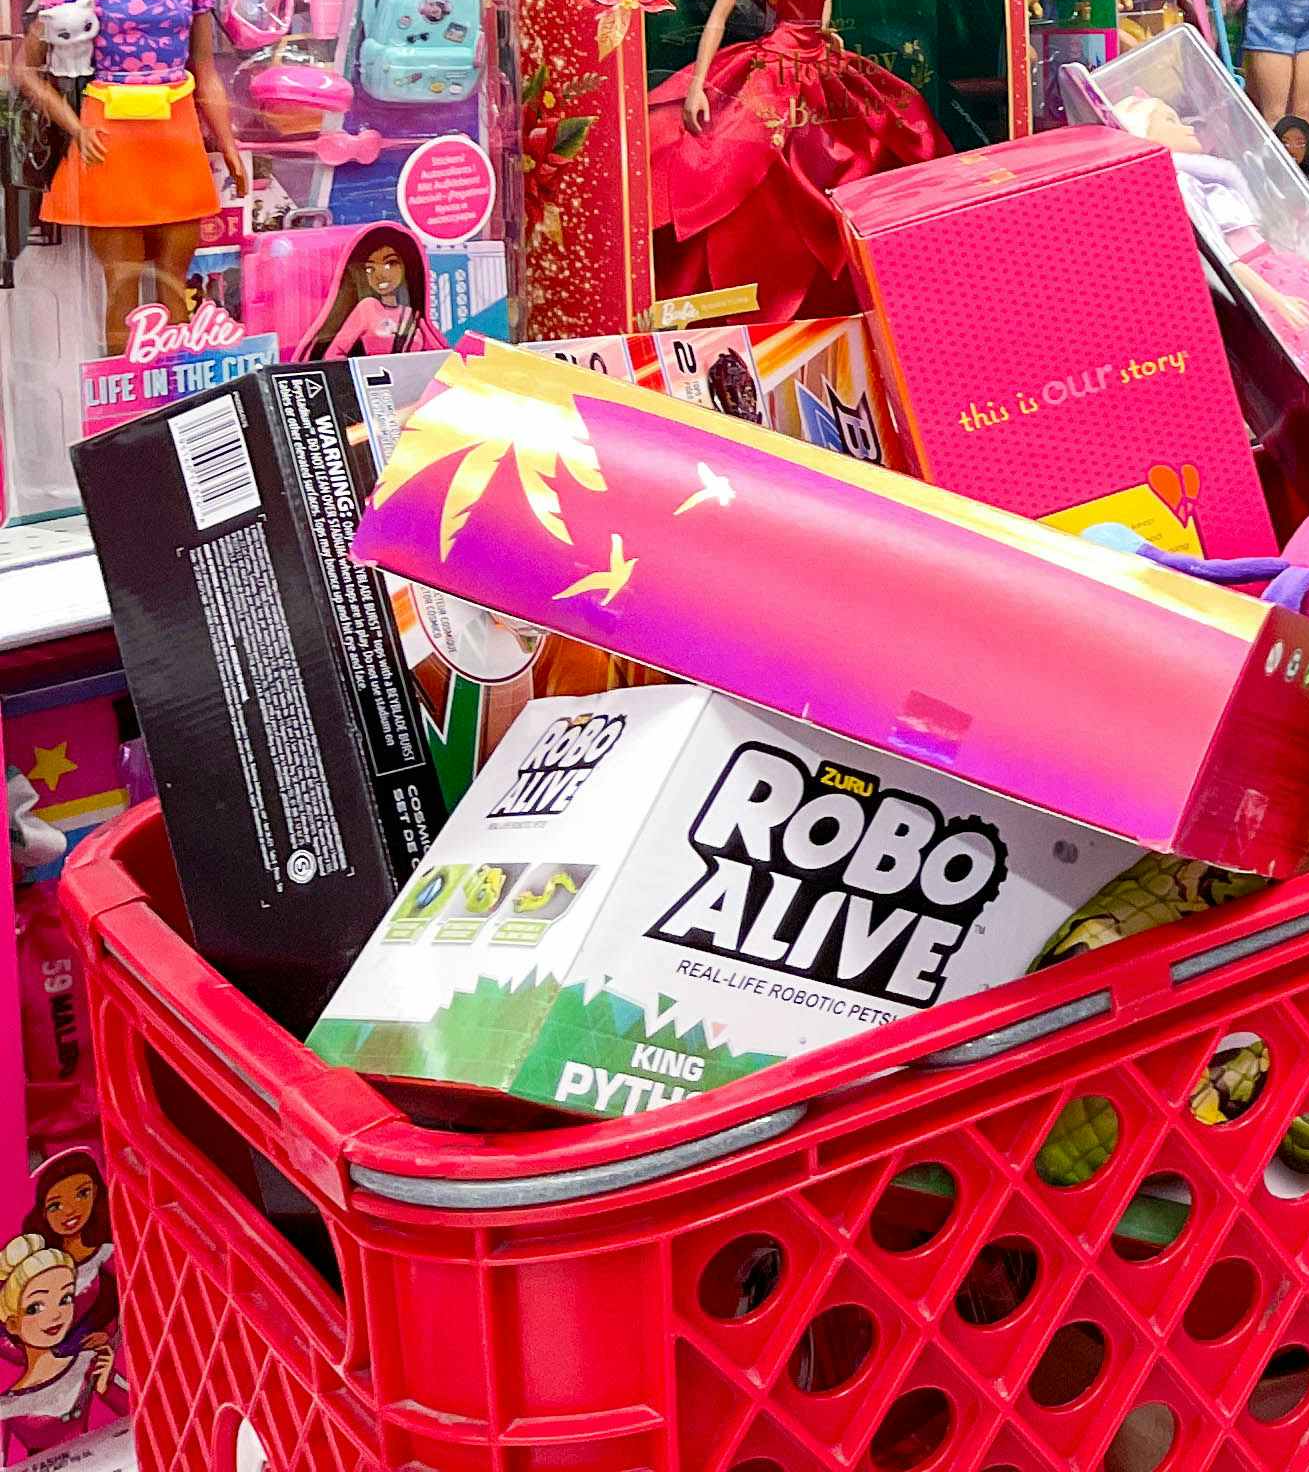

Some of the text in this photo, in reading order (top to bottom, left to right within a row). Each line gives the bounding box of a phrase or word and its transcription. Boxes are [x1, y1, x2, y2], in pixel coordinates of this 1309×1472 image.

[130, 307, 244, 363] Barbie
[86, 374, 137, 406] LIFE
[144, 368, 168, 398] IN
[174, 360, 216, 393] THE
[278, 380, 293, 406] tables
[959, 401, 1010, 433] this
[1016, 391, 1040, 415] is
[1119, 351, 1185, 384] story
[288, 417, 302, 440] other
[295, 442, 311, 477] elevated
[310, 451, 324, 469] NOT
[317, 416, 353, 516] WARNING:
[316, 471, 330, 493] LEAN
[305, 481, 322, 516] surfaces.
[322, 494, 336, 515] OVER
[315, 518, 327, 537] Tops
[328, 519, 347, 556] STADIUM
[341, 521, 356, 541] Only
[320, 538, 332, 556] may
[325, 558, 341, 590] bounce
[338, 558, 353, 583] when
[345, 584, 359, 602] tops
[337, 604, 349, 620] and
[346, 636, 357, 651] eye
[357, 629, 371, 650] play.
[374, 639, 388, 658] tops
[350, 652, 362, 669] and
[366, 664, 379, 679] not
[379, 659, 393, 678] with
[355, 671, 367, 691] face.
[371, 680, 383, 695] use
[375, 697, 392, 732] stadium
[388, 688, 407, 731] BEYBLADE
[384, 733, 396, 746] on
[399, 733, 416, 761] BURST
[525, 717, 625, 771] ROBO
[492, 768, 592, 818] ALIVE
[821, 766, 876, 797] ZURU
[693, 750, 1001, 909] ROBO
[660, 853, 963, 1000] ALIVE
[677, 958, 767, 995] REAL-LIFE
[769, 983, 846, 1017] ROBOTIC
[630, 1042, 705, 1084] KING
